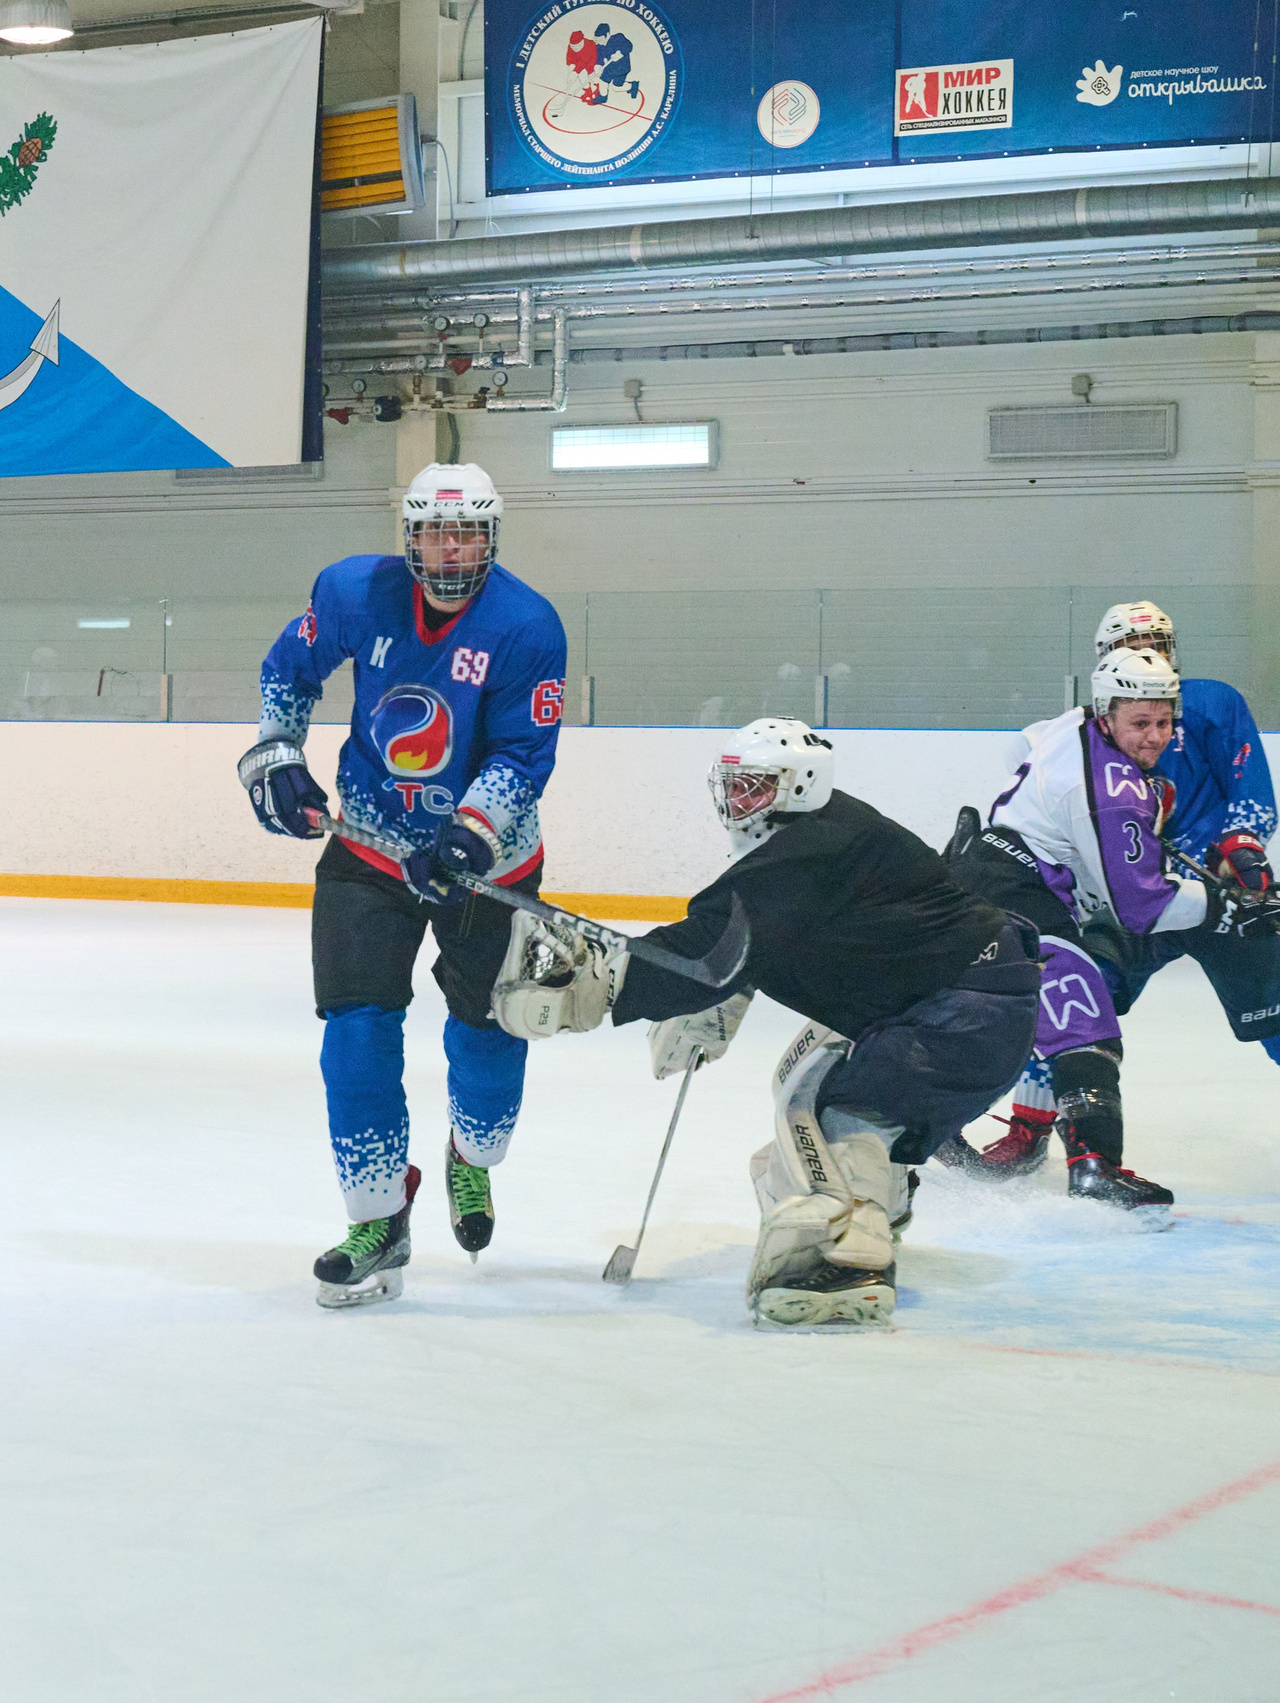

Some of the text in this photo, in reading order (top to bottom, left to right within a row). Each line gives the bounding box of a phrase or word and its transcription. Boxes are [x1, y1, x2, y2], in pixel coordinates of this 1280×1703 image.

[521, 4, 563, 61] ДЕТСКИЙ
[635, 4, 674, 55] ХОККЕЮ
[943, 67, 1001, 89] МИР
[1128, 75, 1267, 105] открывашка
[1130, 65, 1219, 79] детское научное шоу
[513, 84, 528, 137] МЕМОРИАЛ
[527, 135, 562, 168] СТАРШЕГО
[561, 162, 615, 175] ЛЕЙТЕНАНТА
[614, 135, 654, 170] ПОЛИЦИИ
[660, 69, 677, 121] КАРЕЛИНА
[942, 88, 1007, 115] ХОККЕЯ
[451, 647, 489, 687] 69
[531, 678, 566, 727] 6
[394, 782, 455, 815] ТС
[1123, 821, 1145, 864] 3
[553, 910, 628, 953] CCM
[1240, 1004, 1280, 1023] BAU
[778, 1028, 816, 1084] BAUER
[795, 1124, 828, 1182] BAUER
